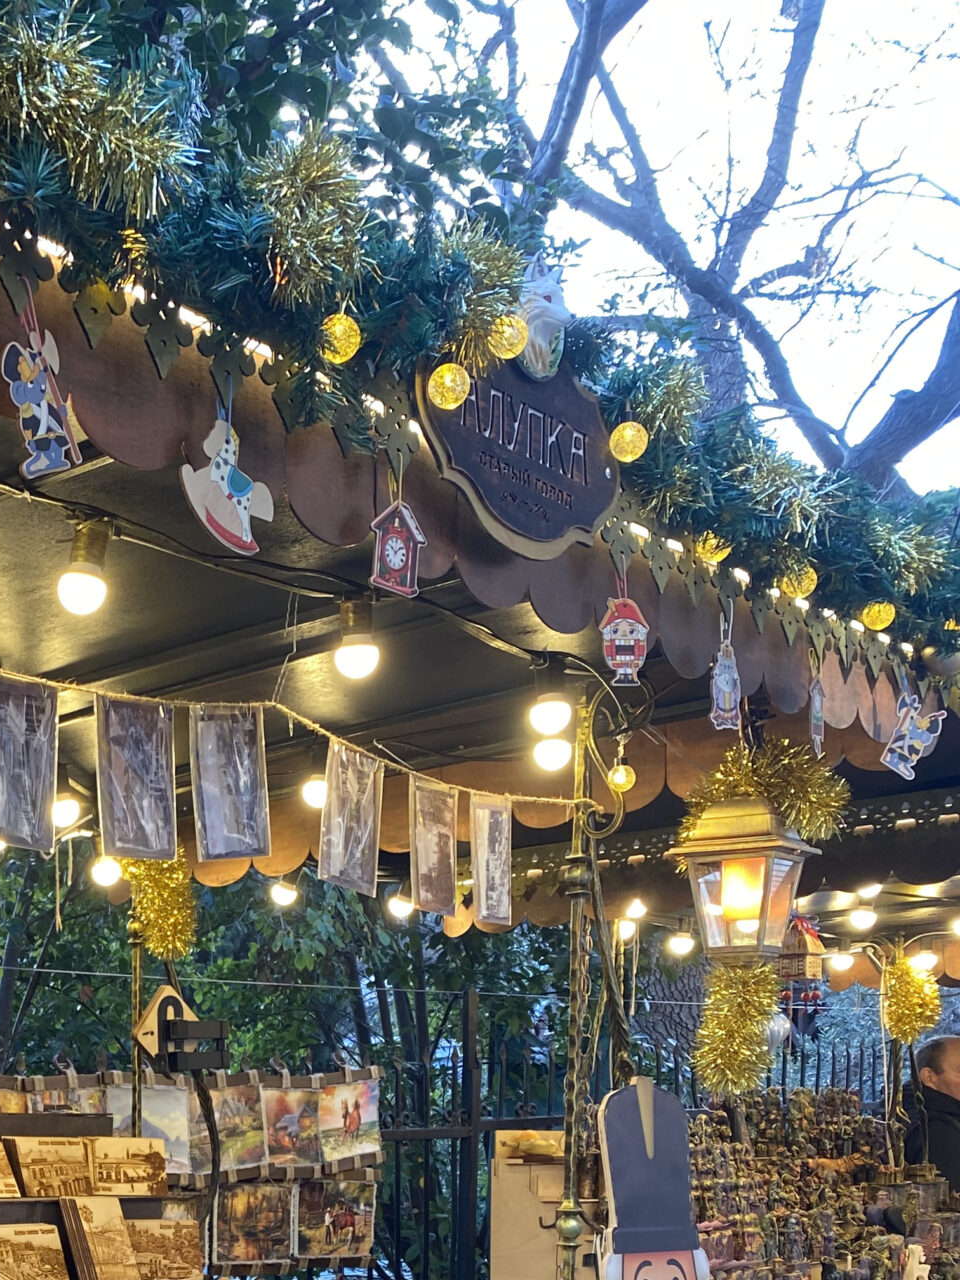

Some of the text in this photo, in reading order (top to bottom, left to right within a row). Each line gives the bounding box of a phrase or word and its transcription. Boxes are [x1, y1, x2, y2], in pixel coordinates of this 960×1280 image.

[460, 377, 588, 486] АЛУПКА
[479, 451, 573, 511] СТАРЫЙ ГОРОД
